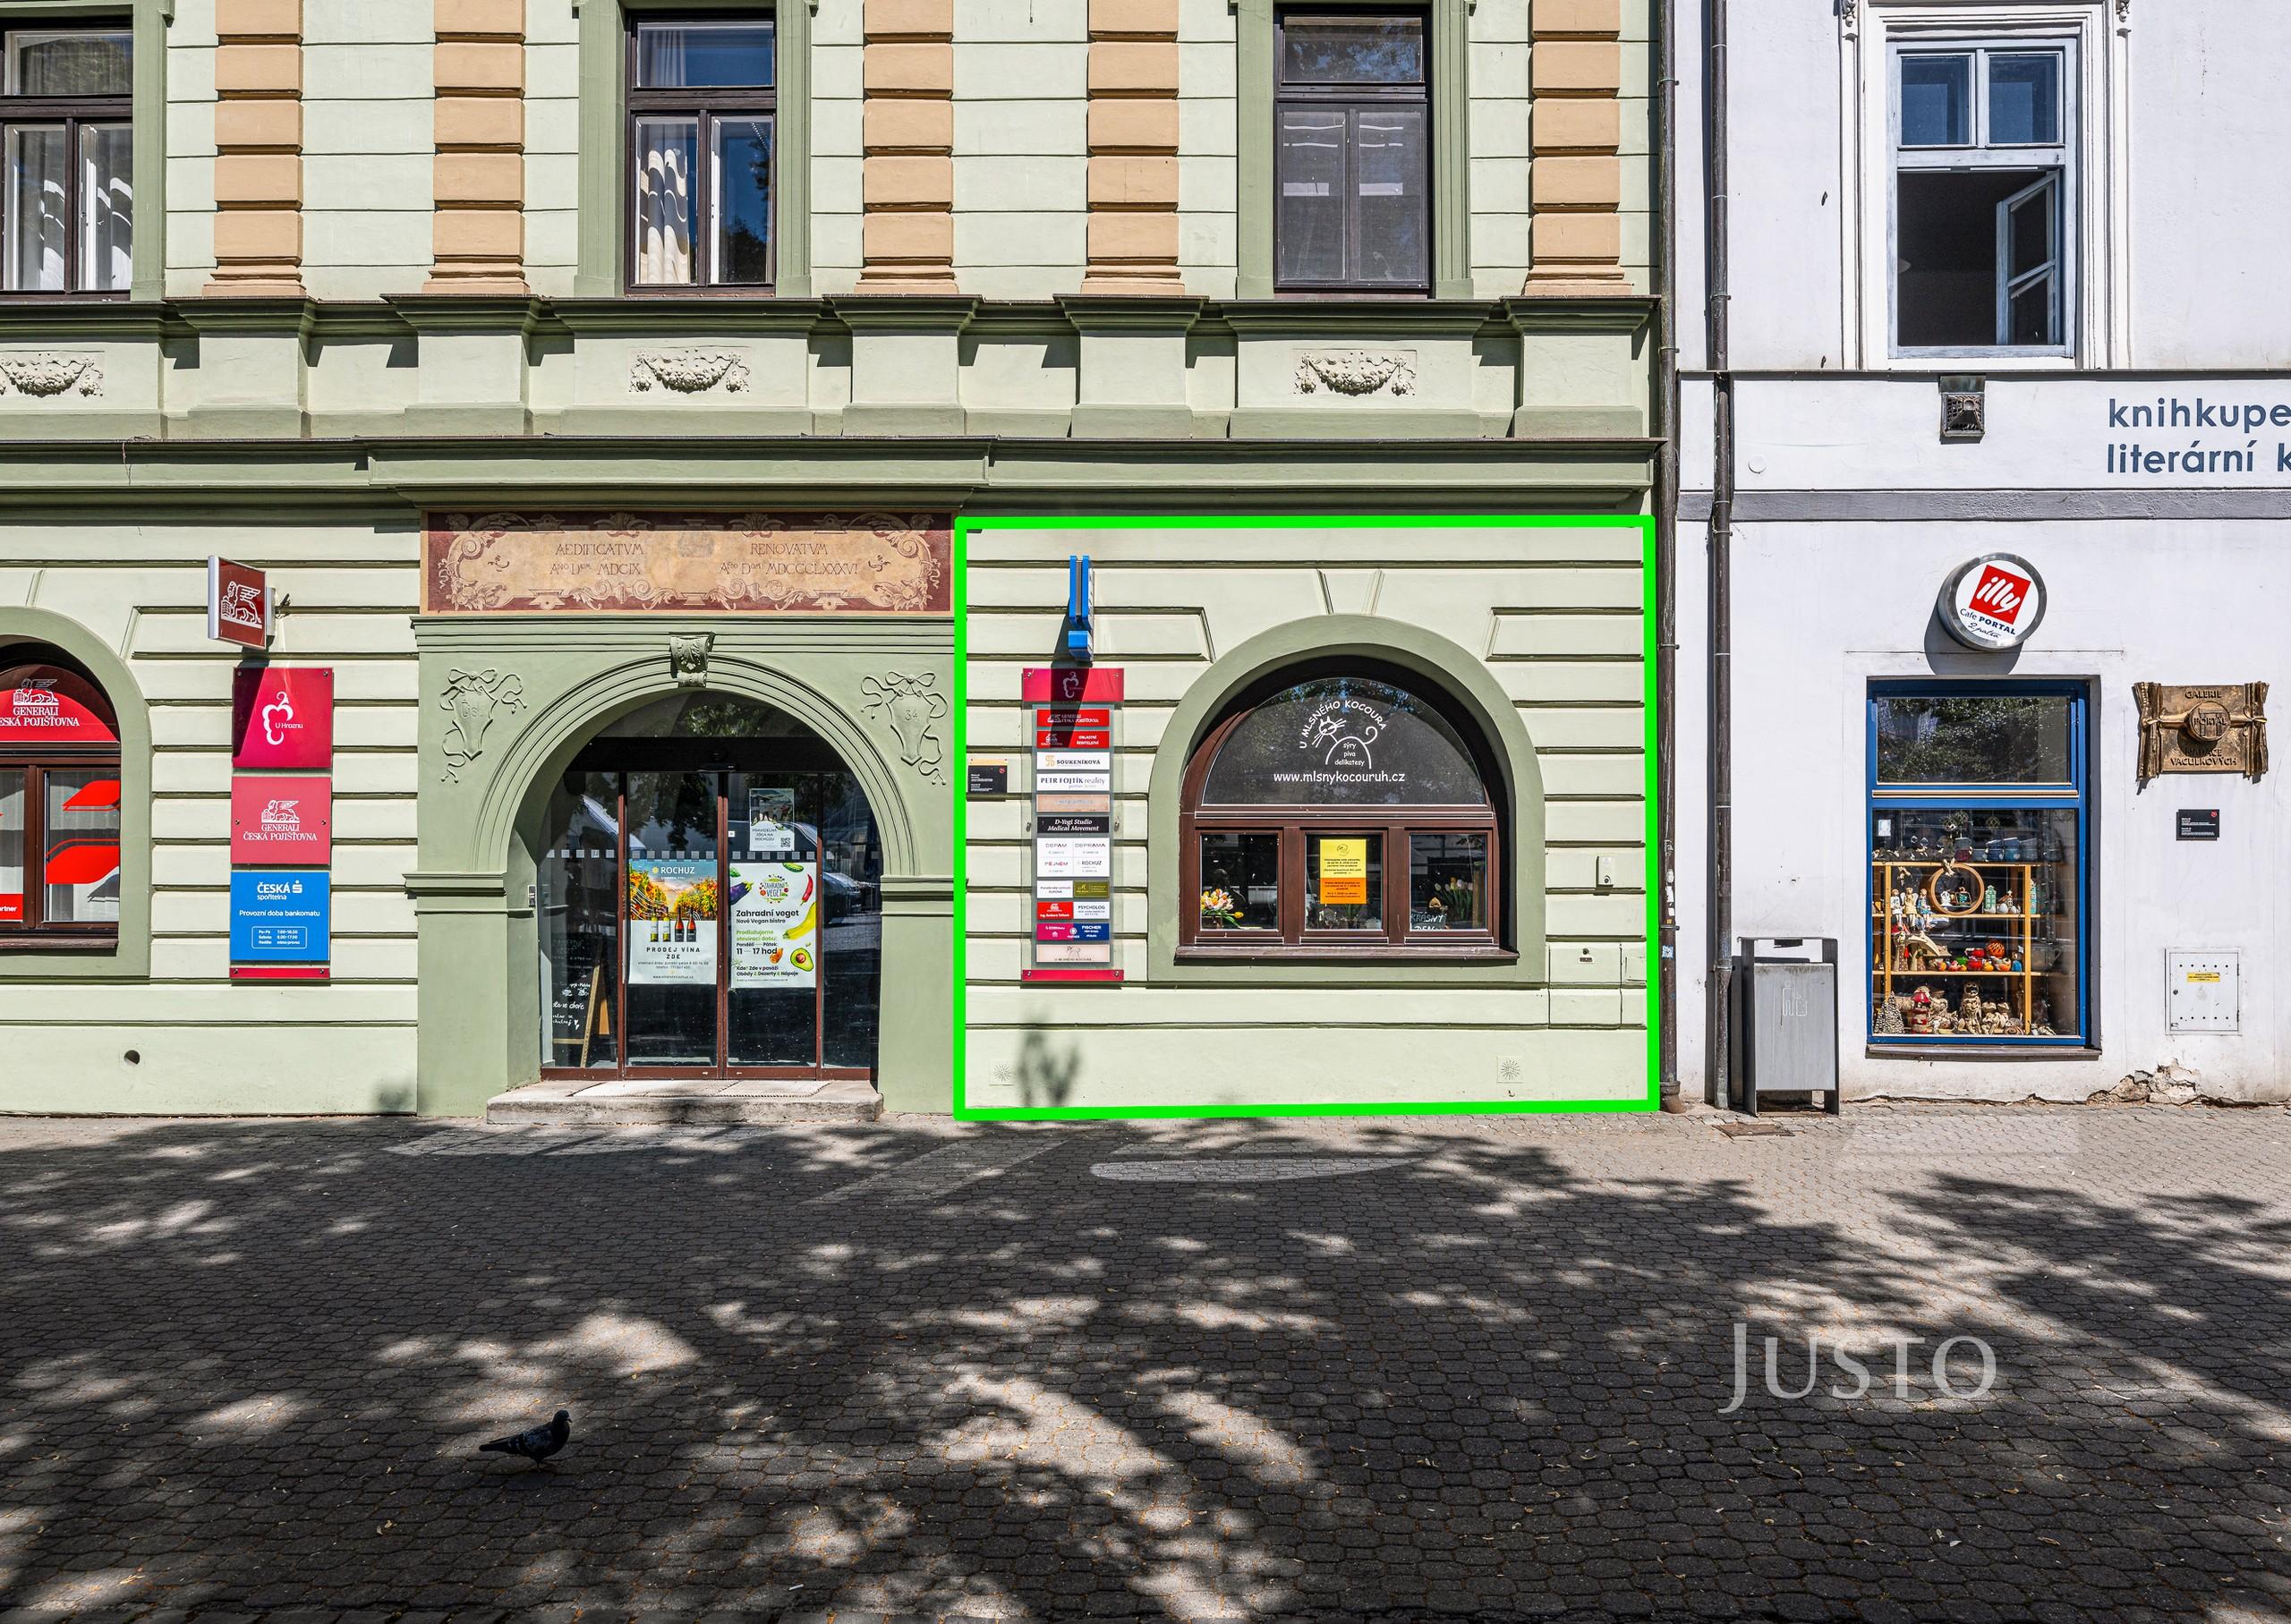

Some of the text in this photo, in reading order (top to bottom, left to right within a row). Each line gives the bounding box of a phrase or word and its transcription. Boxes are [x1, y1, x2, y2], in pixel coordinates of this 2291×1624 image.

[2108, 397, 2291, 434] knihkupe
[2108, 439, 2258, 473] literární
[555, 543, 645, 556] AEDIFICATVM
[750, 542, 829, 557] RENOVATVM
[597, 563, 642, 574] MDCIX
[1976, 576, 2021, 614] illy
[1960, 608, 2016, 635] Cafe PORTAL
[2185, 690, 2222, 699] GALERIE
[13, 706, 59, 716] GENERALI
[23, 715, 80, 727] POJIŠŤOVNA
[1301, 701, 1341, 738] MLSNÉHO
[1344, 700, 1387, 730] KOCOURA
[1342, 742, 1357, 750] sýry
[1334, 759, 1366, 767] delikatesy
[1084, 777, 1105, 785] reality
[1273, 770, 1406, 786] www.mlsnykocouruh.cz
[261, 823, 300, 831] GENERALI
[243, 831, 317, 841] ČESKÁ POJIŠŤOVNA
[660, 866, 695, 874] ROCHUZ
[257, 881, 291, 894] ČESKÁ
[767, 889, 783, 897] VEGET
[736, 909, 799, 918] Zahradní veget
[761, 947, 778, 955] hod
